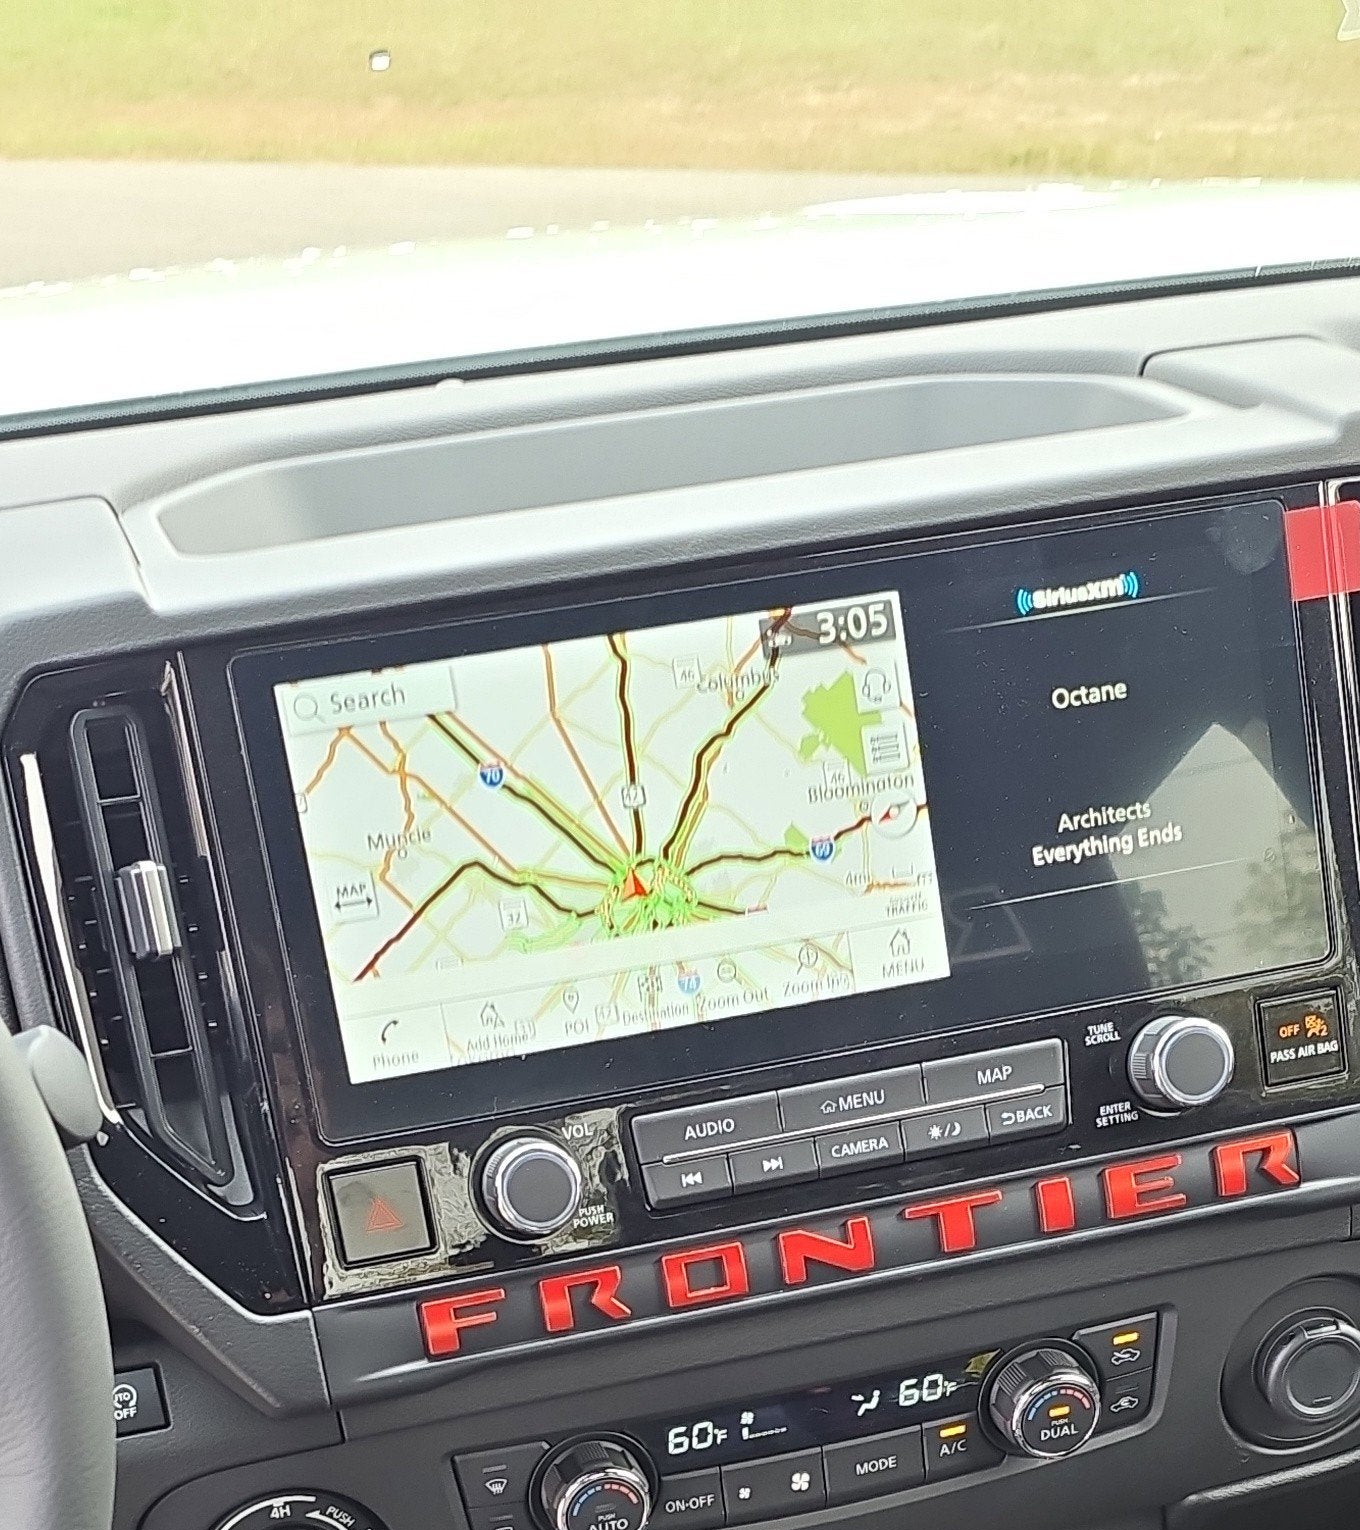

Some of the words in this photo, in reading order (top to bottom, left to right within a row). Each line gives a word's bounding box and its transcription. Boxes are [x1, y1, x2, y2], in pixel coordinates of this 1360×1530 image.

[817, 602, 888, 645] 3:05
[696, 668, 780, 693] Columbus
[330, 682, 406, 715] Search
[1051, 680, 1128, 710] Octane
[808, 774, 915, 803] Bloomington
[1057, 801, 1151, 832] Architects
[1032, 832, 1134, 867] Everything
[1138, 822, 1183, 850] Ends
[336, 883, 368, 898] MAP
[882, 957, 926, 979] MENU
[783, 978, 822, 998] Zoom
[697, 993, 740, 1013] Zoom
[743, 987, 770, 1005] Out
[622, 1003, 690, 1027] Destination
[1084, 1029, 1122, 1046] SCROLL
[1087, 1021, 1115, 1036] TUNE
[1279, 1023, 1300, 1039] OFF
[373, 1051, 420, 1068] Phone
[1270, 1048, 1296, 1064] PASS
[1297, 1044, 1316, 1058] AIR
[1317, 1040, 1339, 1055] BAG
[977, 1064, 1013, 1085] MAP
[839, 1088, 886, 1112] MENU
[1099, 1101, 1132, 1116] ENTER
[1015, 1104, 1053, 1124] BACK
[1095, 1110, 1139, 1128] SETTING
[561, 1123, 594, 1141] VOL
[684, 1118, 736, 1140] AUDIO
[830, 1135, 889, 1157] CAMERA
[573, 1211, 615, 1230] POWER
[578, 1204, 605, 1220] PUSH
[419, 1129, 1301, 1357] FRONTIER
[113, 1406, 137, 1421] OFF
[1040, 1422, 1079, 1441] DUAL
[939, 1439, 967, 1458] A/C
[855, 1455, 898, 1476] MODE
[270, 1504, 291, 1520] 4H
[325, 1504, 356, 1529] PUSH
[597, 1512, 616, 1522] PUSH
